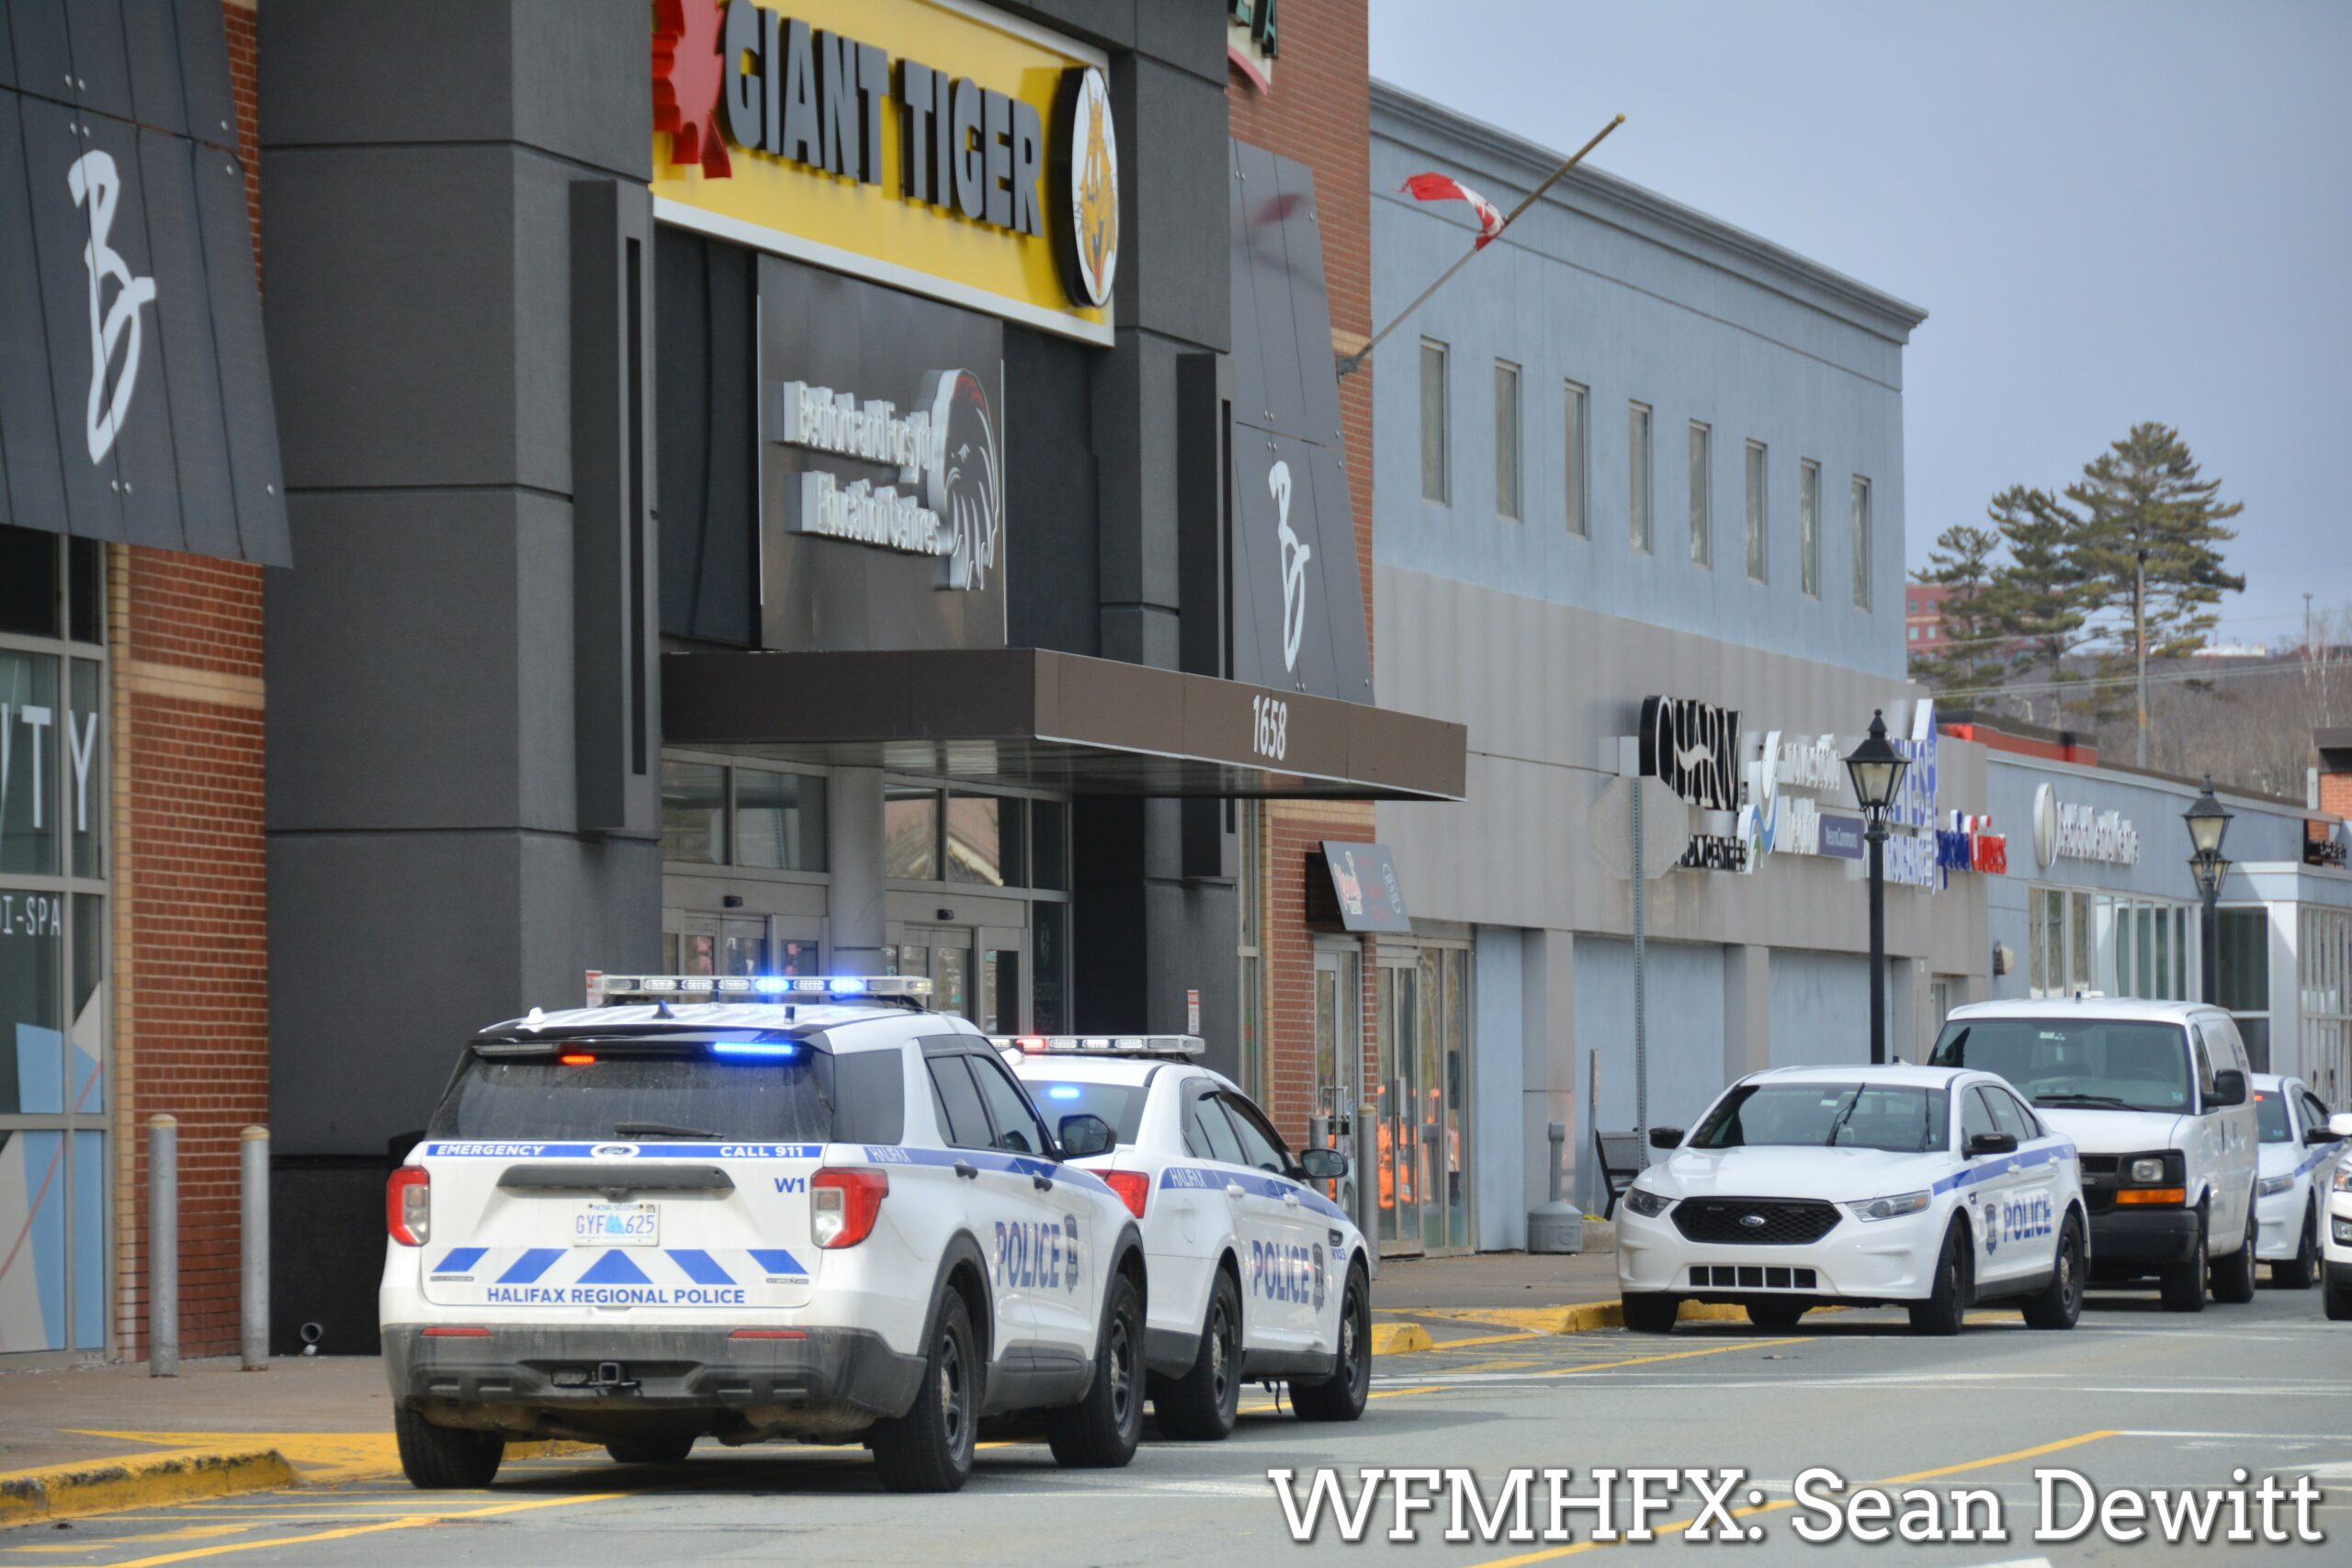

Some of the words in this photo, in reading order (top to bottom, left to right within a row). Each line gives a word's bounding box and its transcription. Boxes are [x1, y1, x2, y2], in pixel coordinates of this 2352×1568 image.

[723, 0, 889, 186] GIANT
[899, 58, 1044, 238] TIGER
[1253, 694, 1286, 761] 1658
[0, 703, 97, 831] TY
[1655, 694, 1743, 813] CHARM
[0, 895, 62, 936] I-SPA
[435, 1145, 545, 1156] EMERGENCY
[720, 1146, 770, 1157] CALL
[775, 1146, 804, 1157] 911
[871, 1147, 911, 1163] HALIFAX
[775, 1178, 805, 1193] W1
[1170, 1168, 1206, 1189] HALIFAX
[575, 1214, 605, 1235] GYF
[626, 1214, 655, 1235] 625
[2003, 1194, 2052, 1243] POLICE
[994, 1222, 1061, 1289] POLICE
[1252, 1240, 1309, 1304] POLICE
[487, 1288, 567, 1303] HALIFAX
[571, 1289, 669, 1303] REGIONAL
[674, 1290, 745, 1304] POLICE
